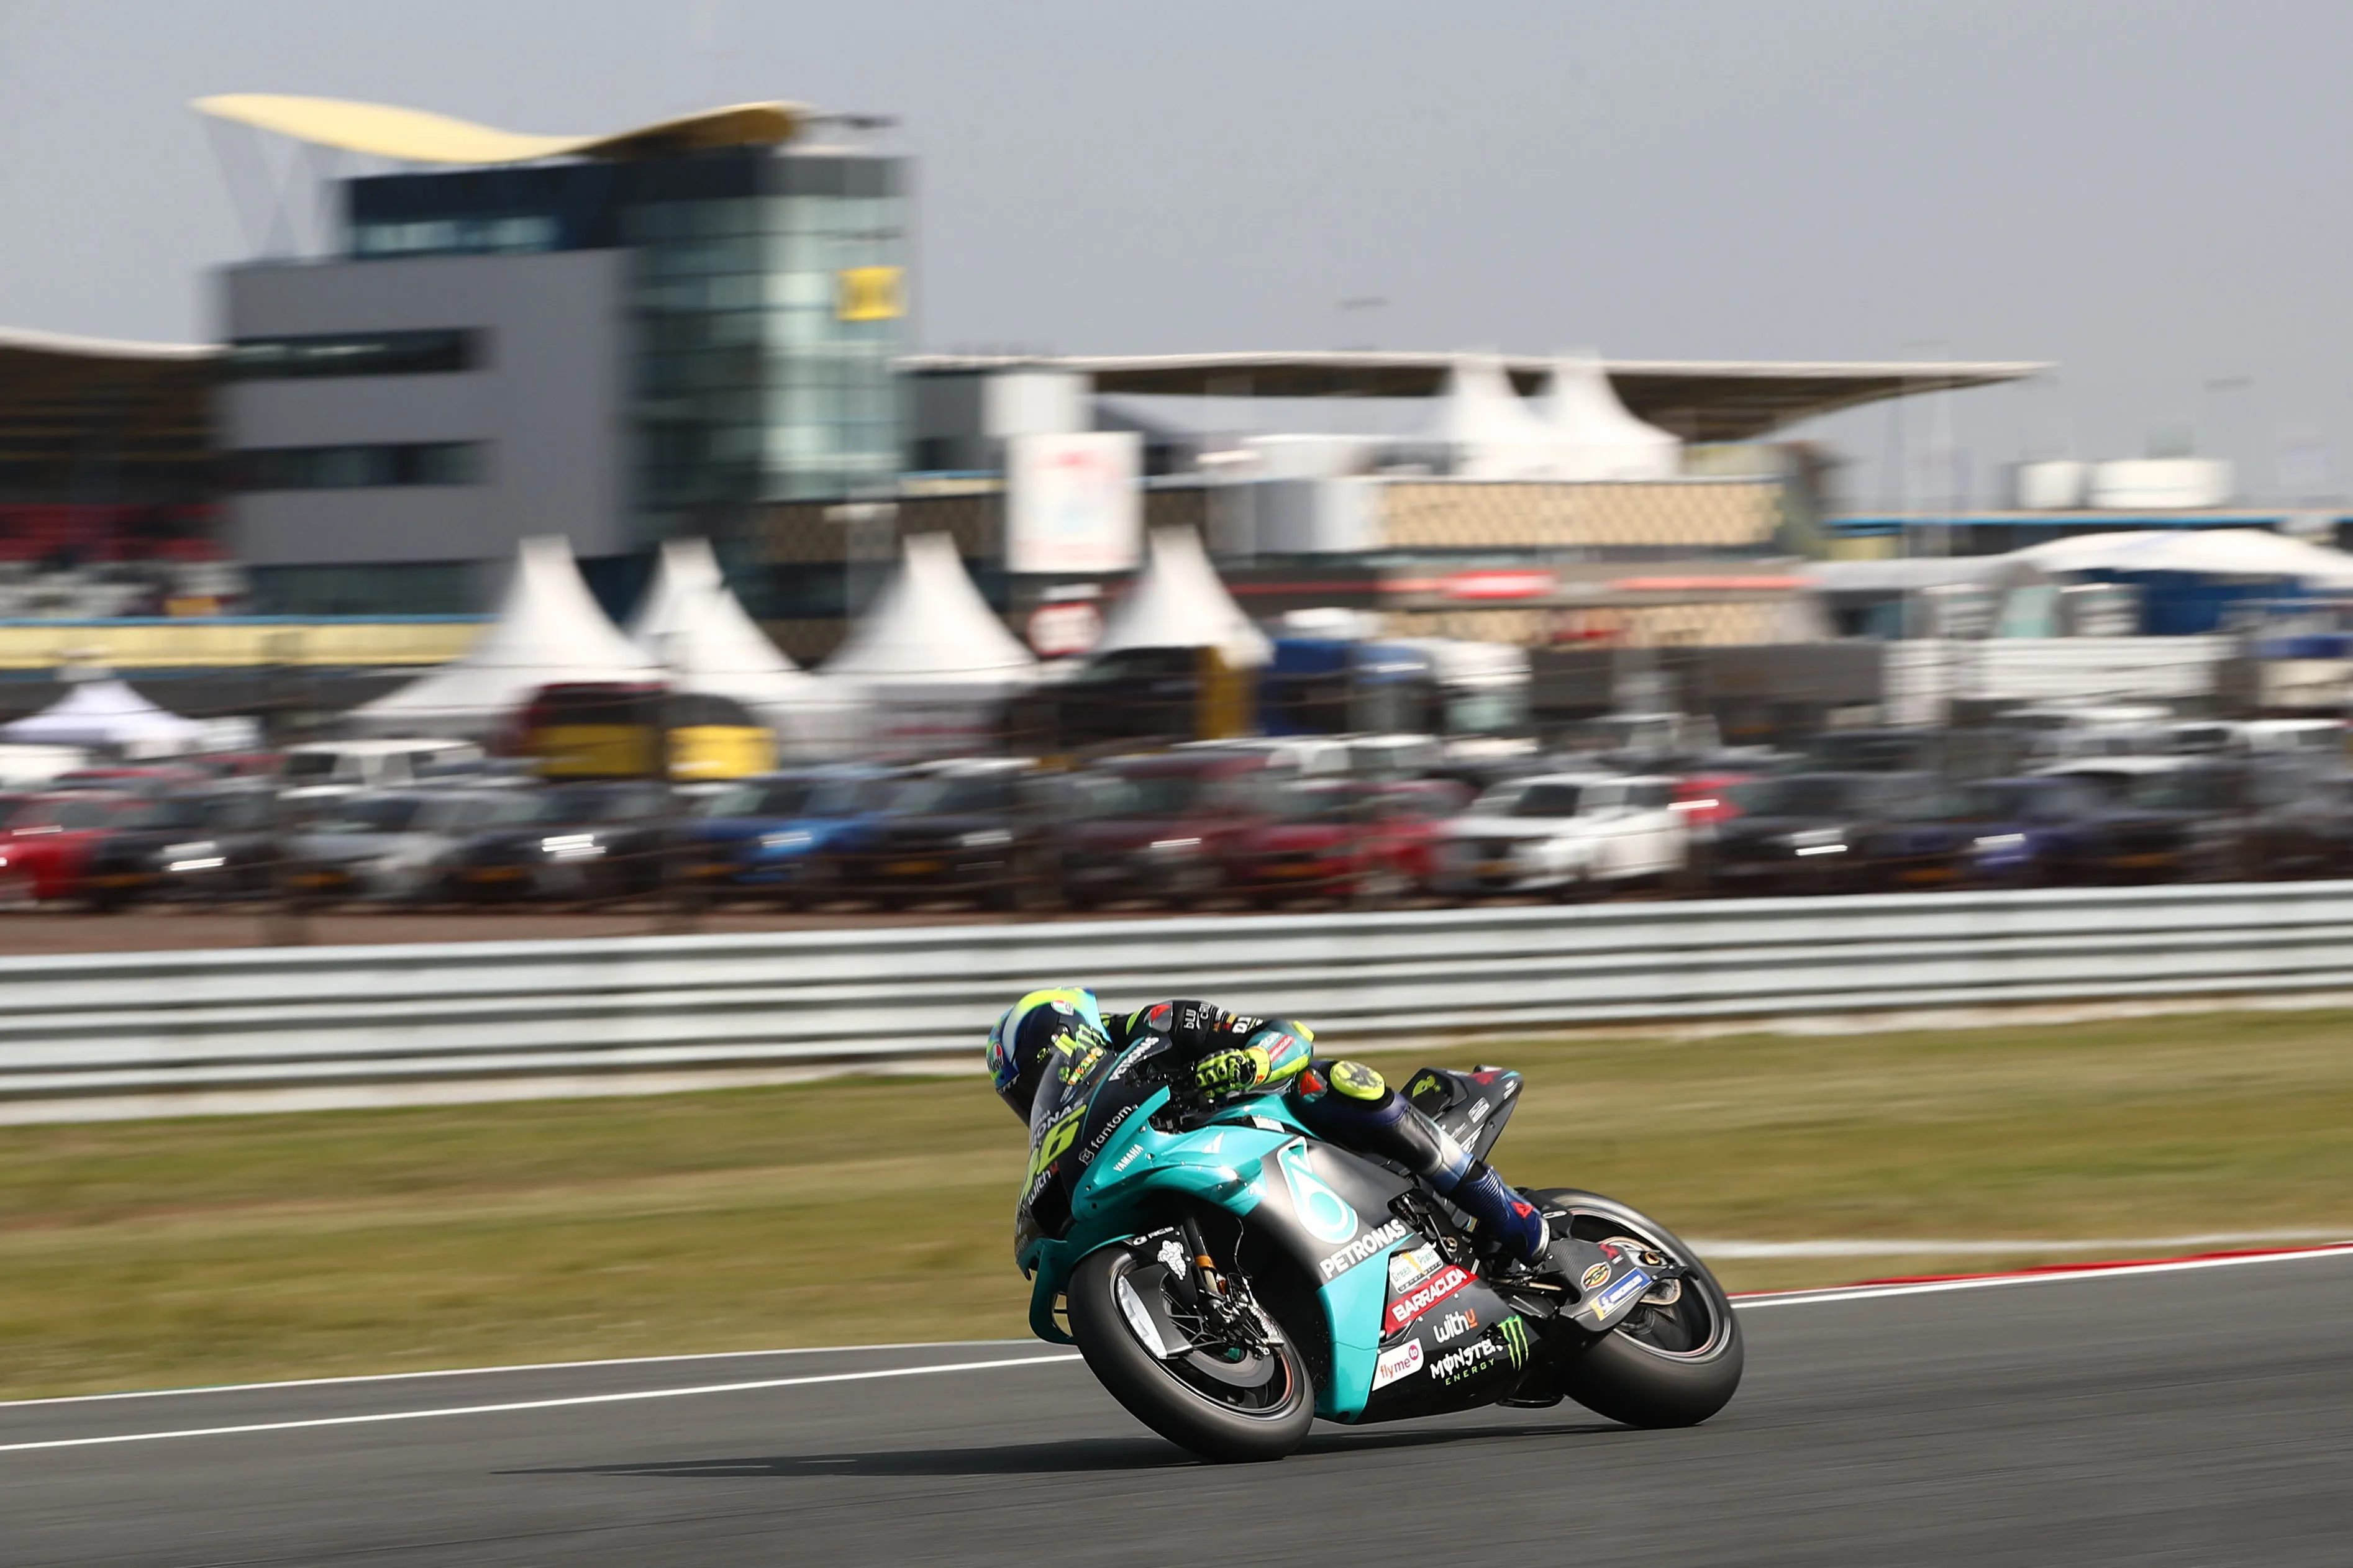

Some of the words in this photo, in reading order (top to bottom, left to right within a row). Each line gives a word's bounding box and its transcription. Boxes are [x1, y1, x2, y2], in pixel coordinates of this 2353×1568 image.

[1113, 1143, 1144, 1172] YAMAHA
[1319, 1218, 1407, 1279] PETRONAS
[1391, 1266, 1412, 1282] Green
[1392, 1268, 1467, 1322] BARRACUDA
[1445, 1358, 1495, 1386] ENERGY
